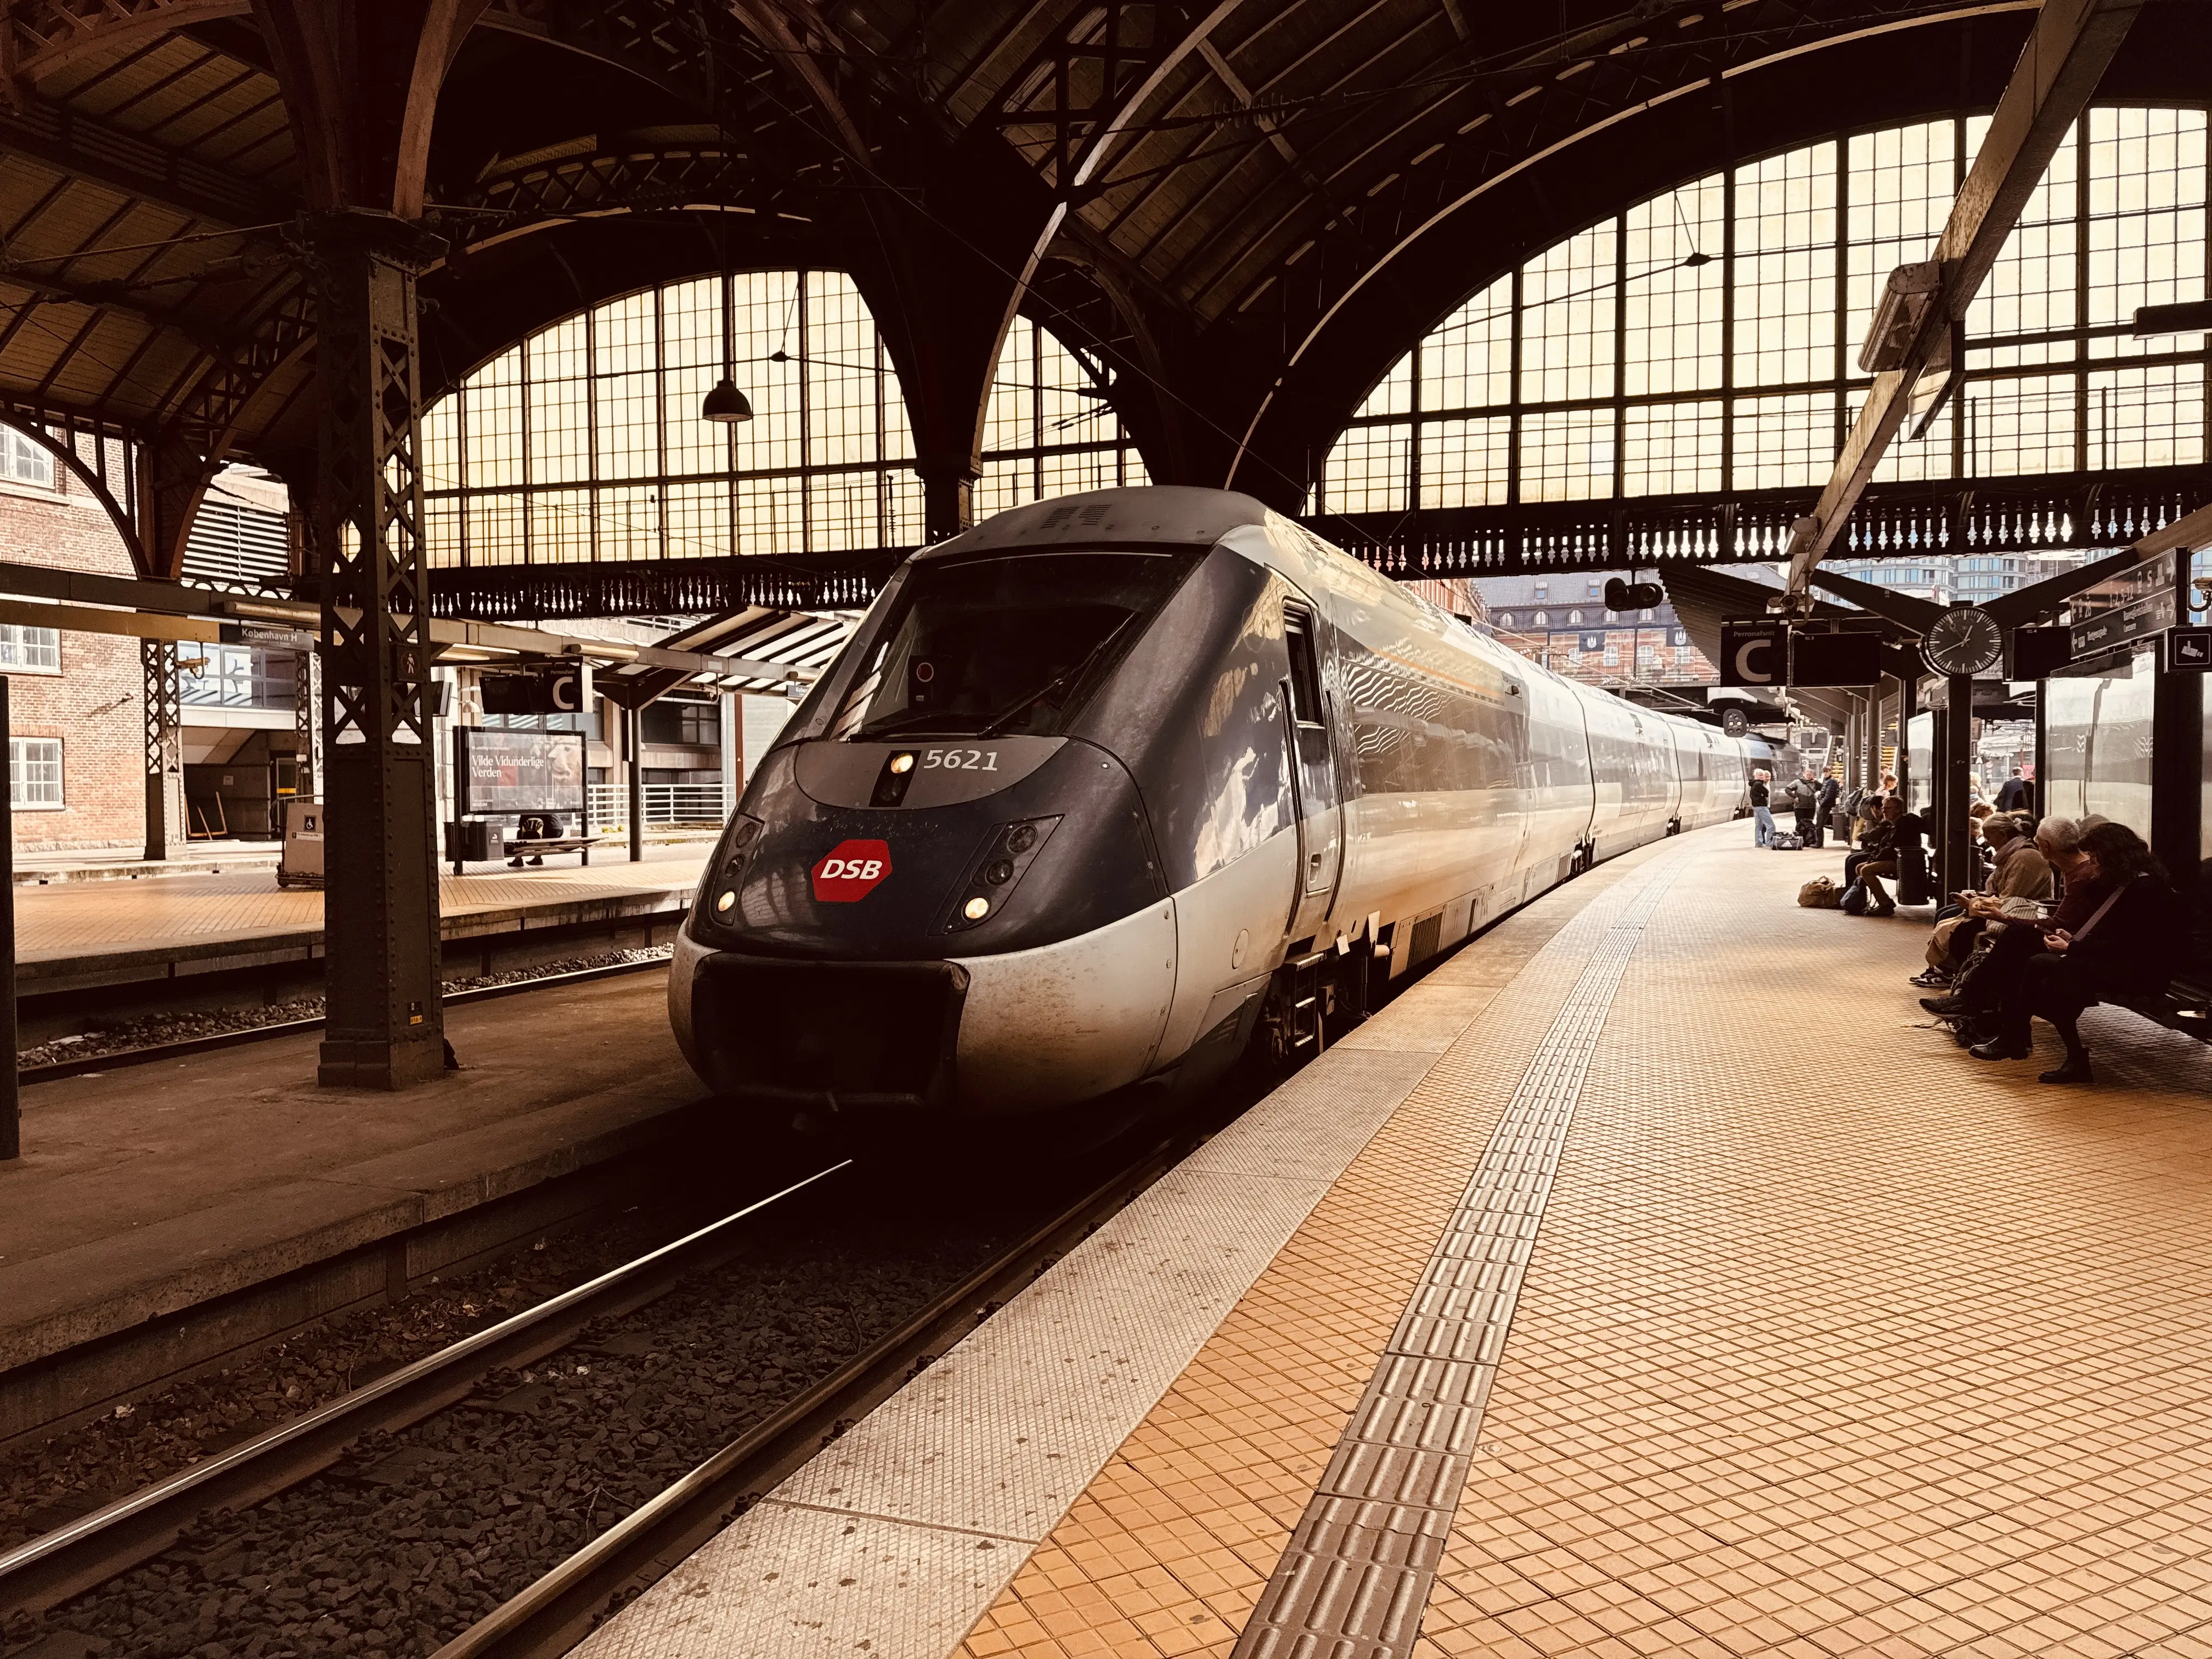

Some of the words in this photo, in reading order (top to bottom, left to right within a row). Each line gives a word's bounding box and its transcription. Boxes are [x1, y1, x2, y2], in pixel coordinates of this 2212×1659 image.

[2147, 569, 2153, 588] S
[291, 633, 297, 642] H
[1736, 639, 1771, 682] C
[552, 676, 574, 709] C
[472, 755, 493, 766] Vilde
[495, 755, 544, 769] Vidunderlige
[923, 749, 997, 771] 5621
[472, 766, 501, 777] Verden
[820, 859, 883, 879] DSB
